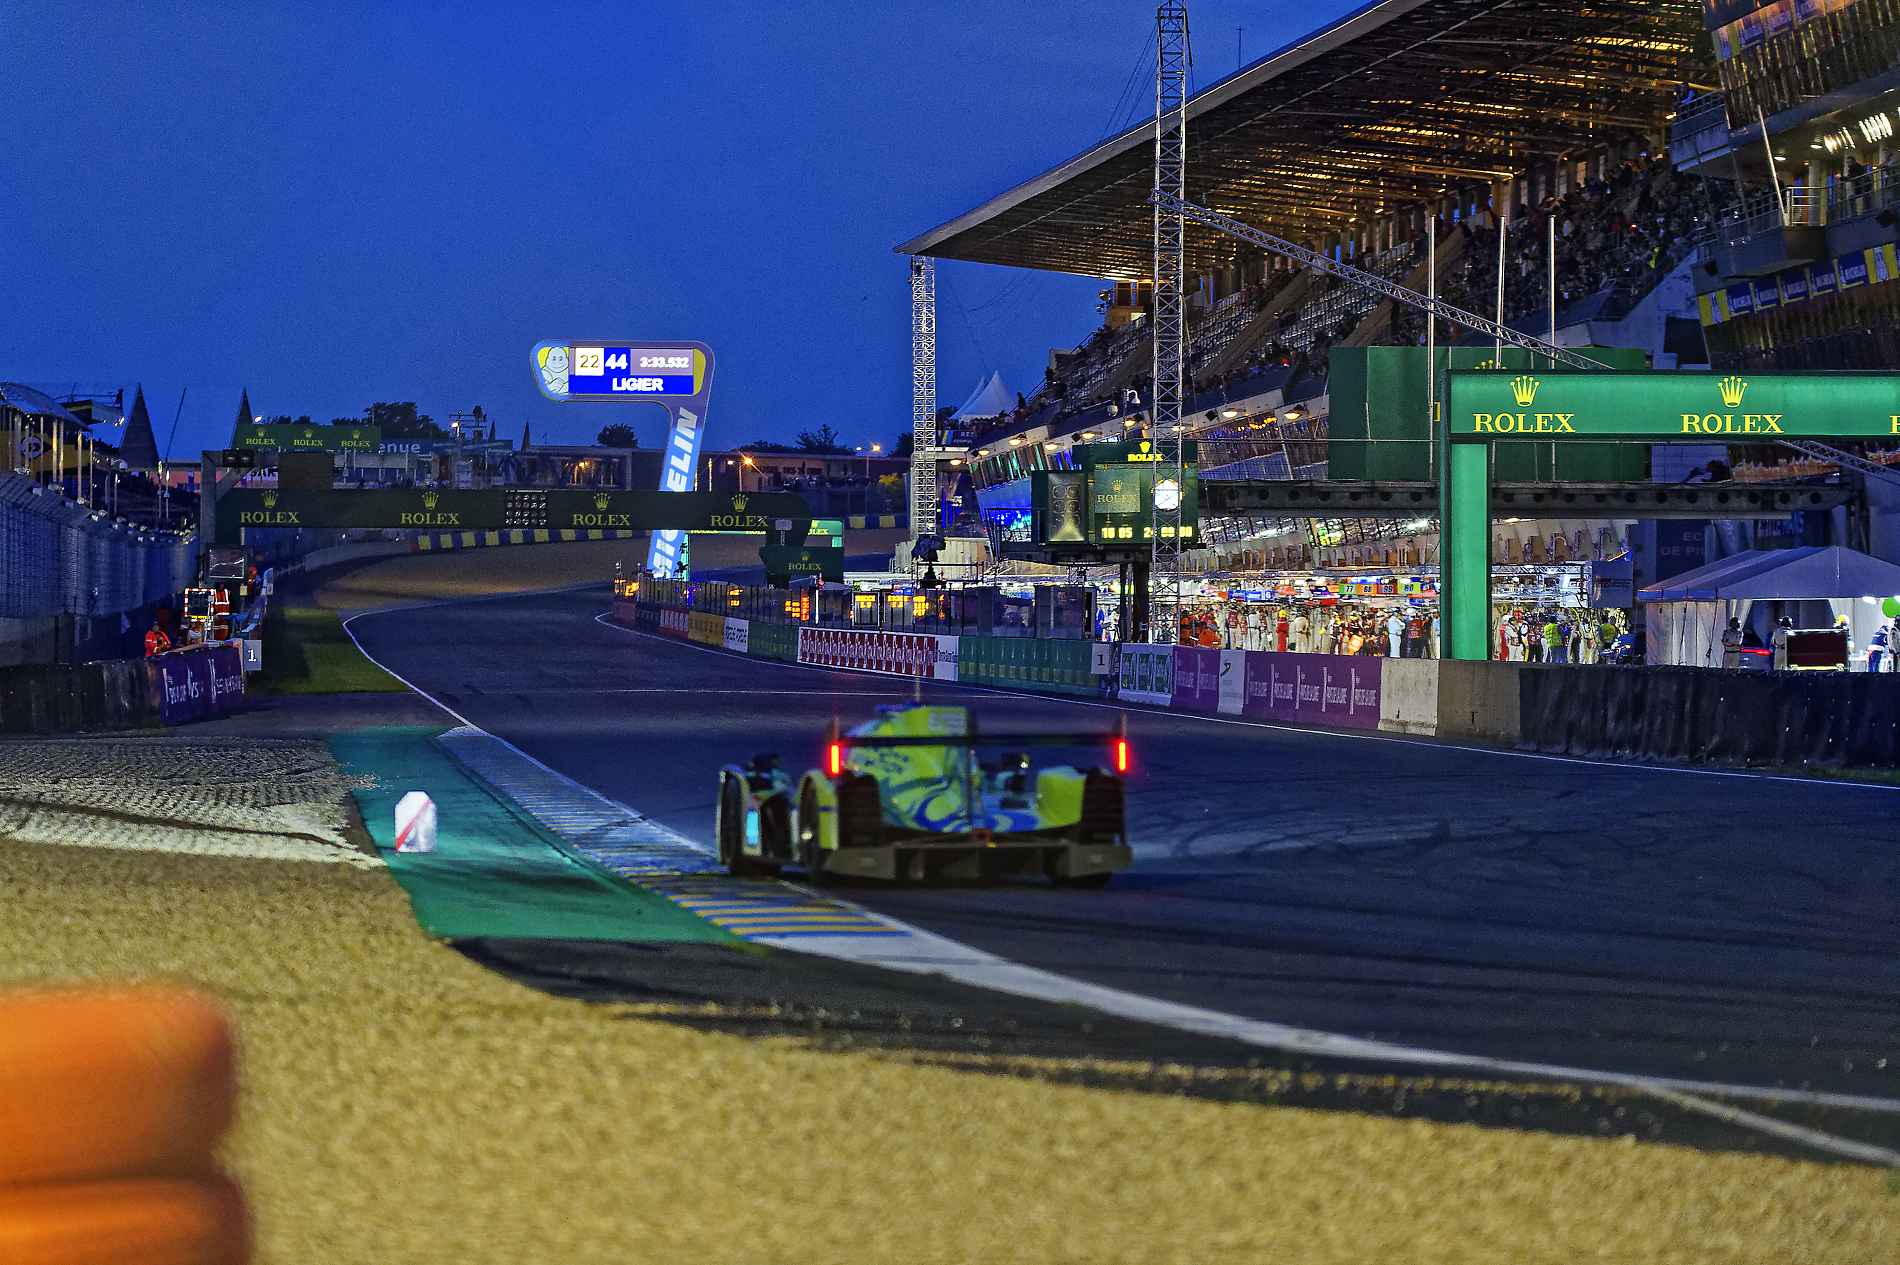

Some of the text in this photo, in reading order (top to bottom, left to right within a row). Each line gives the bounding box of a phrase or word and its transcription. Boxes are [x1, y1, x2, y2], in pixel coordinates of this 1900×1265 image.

[580, 354, 599, 368] 22
[605, 353, 628, 370] 44
[612, 377, 664, 392] LIGIER
[1473, 412, 1576, 434] ROLEX
[1681, 413, 1784, 435] ROLEX
[246, 437, 276, 446] ROLEX
[293, 439, 324, 447] ROLEX
[341, 440, 371, 448] ROLEX
[1127, 453, 1164, 462] ROLEX
[1097, 494, 1137, 503] ROLEX
[240, 511, 300, 524] ROLEX
[401, 512, 461, 525] ROLEX
[572, 513, 631, 526] ROLEX
[711, 514, 768, 527] ROLEX
[788, 562, 822, 571] ROLEX
[248, 649, 257, 662] 1
[1097, 653, 1106, 666] 1
